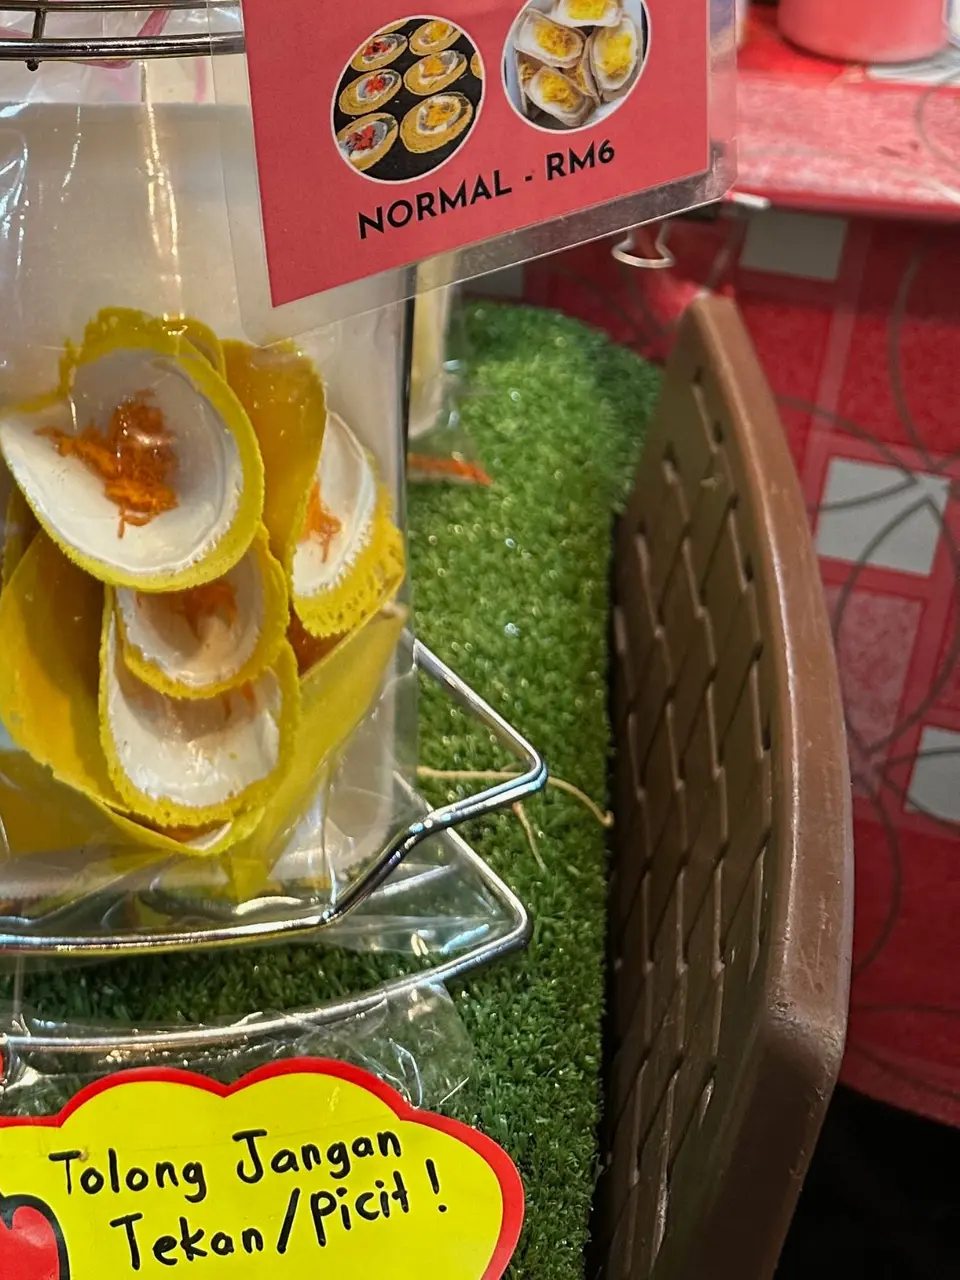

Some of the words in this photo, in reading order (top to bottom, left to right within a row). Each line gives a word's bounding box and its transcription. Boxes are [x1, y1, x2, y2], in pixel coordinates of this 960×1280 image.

[357, 169, 513, 240] NORMAL
[545, 139, 616, 182] RM6
[47, 1147, 208, 1204] Tolong
[231, 1128, 403, 1185] Jangan
